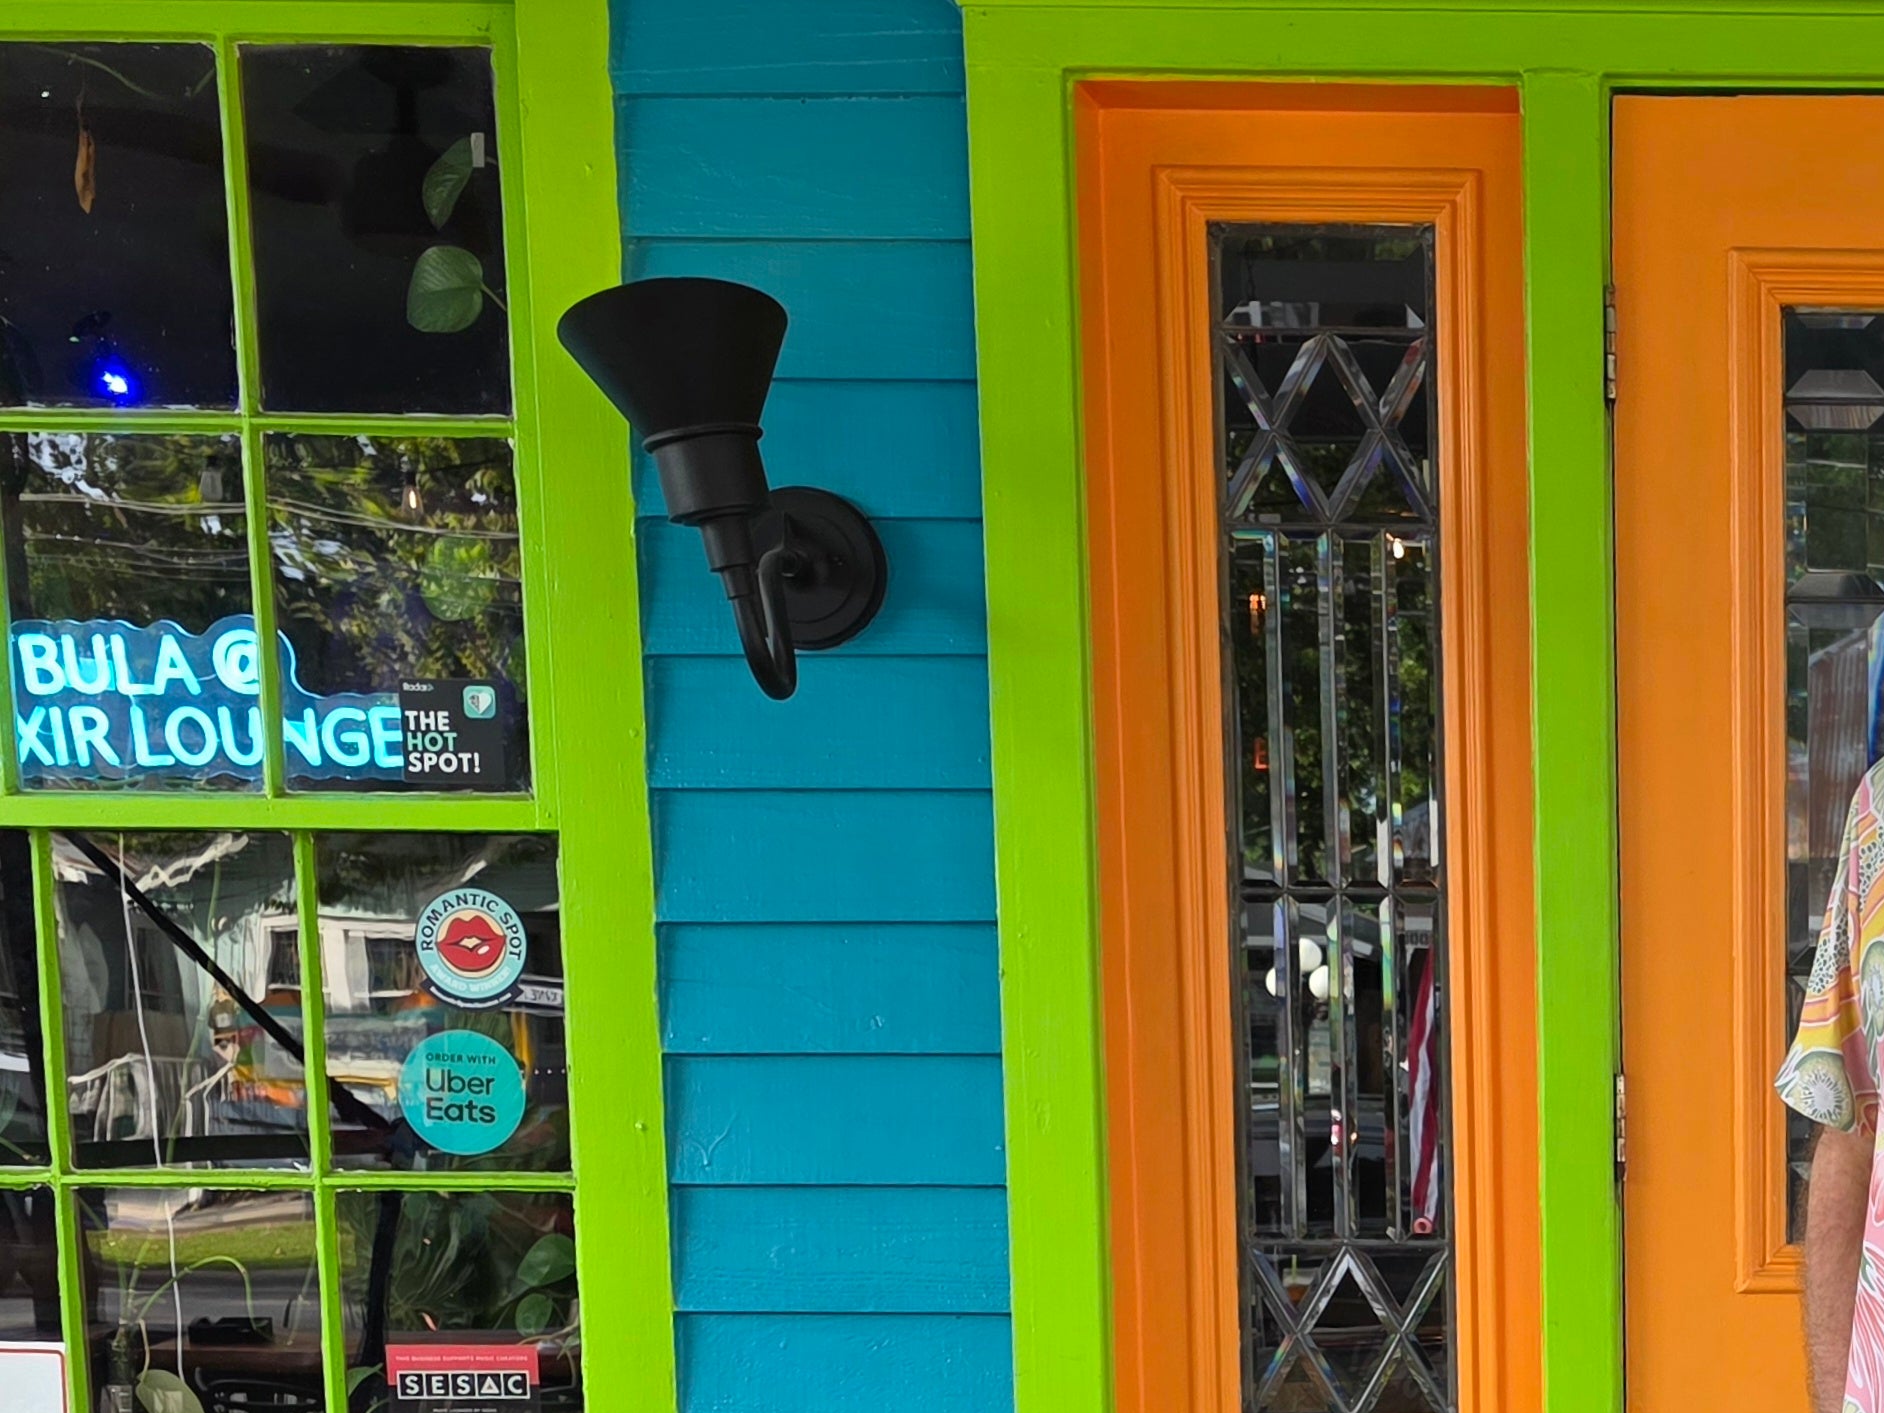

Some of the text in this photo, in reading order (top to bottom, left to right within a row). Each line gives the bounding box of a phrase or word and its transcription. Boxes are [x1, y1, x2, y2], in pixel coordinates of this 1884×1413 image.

[17, 628, 260, 696] BULA @
[404, 710, 450, 732] THE
[130, 704, 403, 769] LOUNGE
[407, 732, 457, 752] HOT
[408, 752, 480, 773] SPOT!
[420, 892, 523, 961] ROMANTIC SPOT
[425, 1053, 496, 1065] ORDER WITH
[425, 1068, 495, 1096] Uber
[426, 1097, 496, 1124] Eats
[405, 1374, 524, 1395] SESAC
